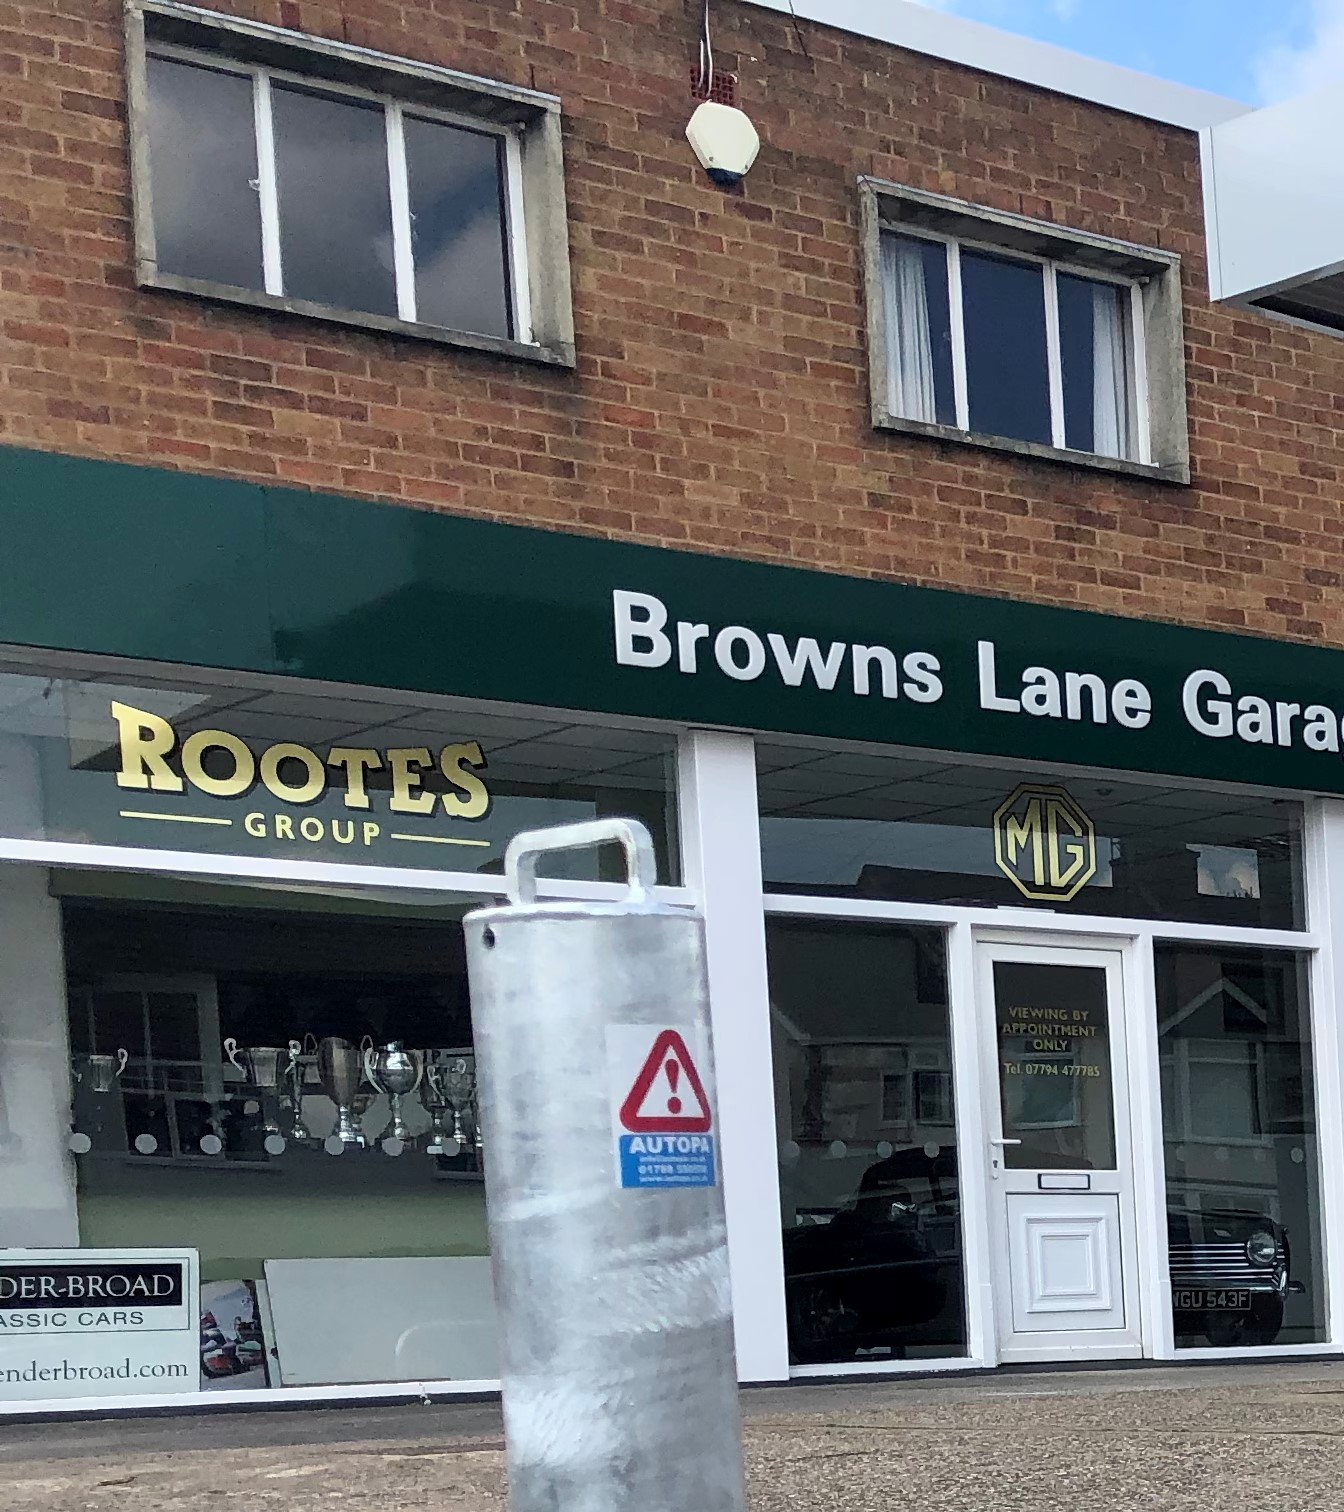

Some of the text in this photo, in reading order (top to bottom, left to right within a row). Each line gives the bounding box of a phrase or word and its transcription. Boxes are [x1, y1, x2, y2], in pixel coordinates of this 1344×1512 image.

[613, 589, 943, 703] Browns
[977, 640, 1151, 728] Lane
[111, 700, 490, 819] ROOTES
[244, 812, 380, 846] GROUP
[1009, 1007, 1089, 1021] VIEWING BY
[1003, 1023, 1097, 1036] APPOINTMENT
[1033, 1039, 1068, 1051] ONLY
[1026, 1064, 1058, 1076] 07794
[629, 1136, 710, 1154] AUTOPA
[1206, 1291, 1249, 1307] 543F
[78, 1311, 144, 1326] CARS
